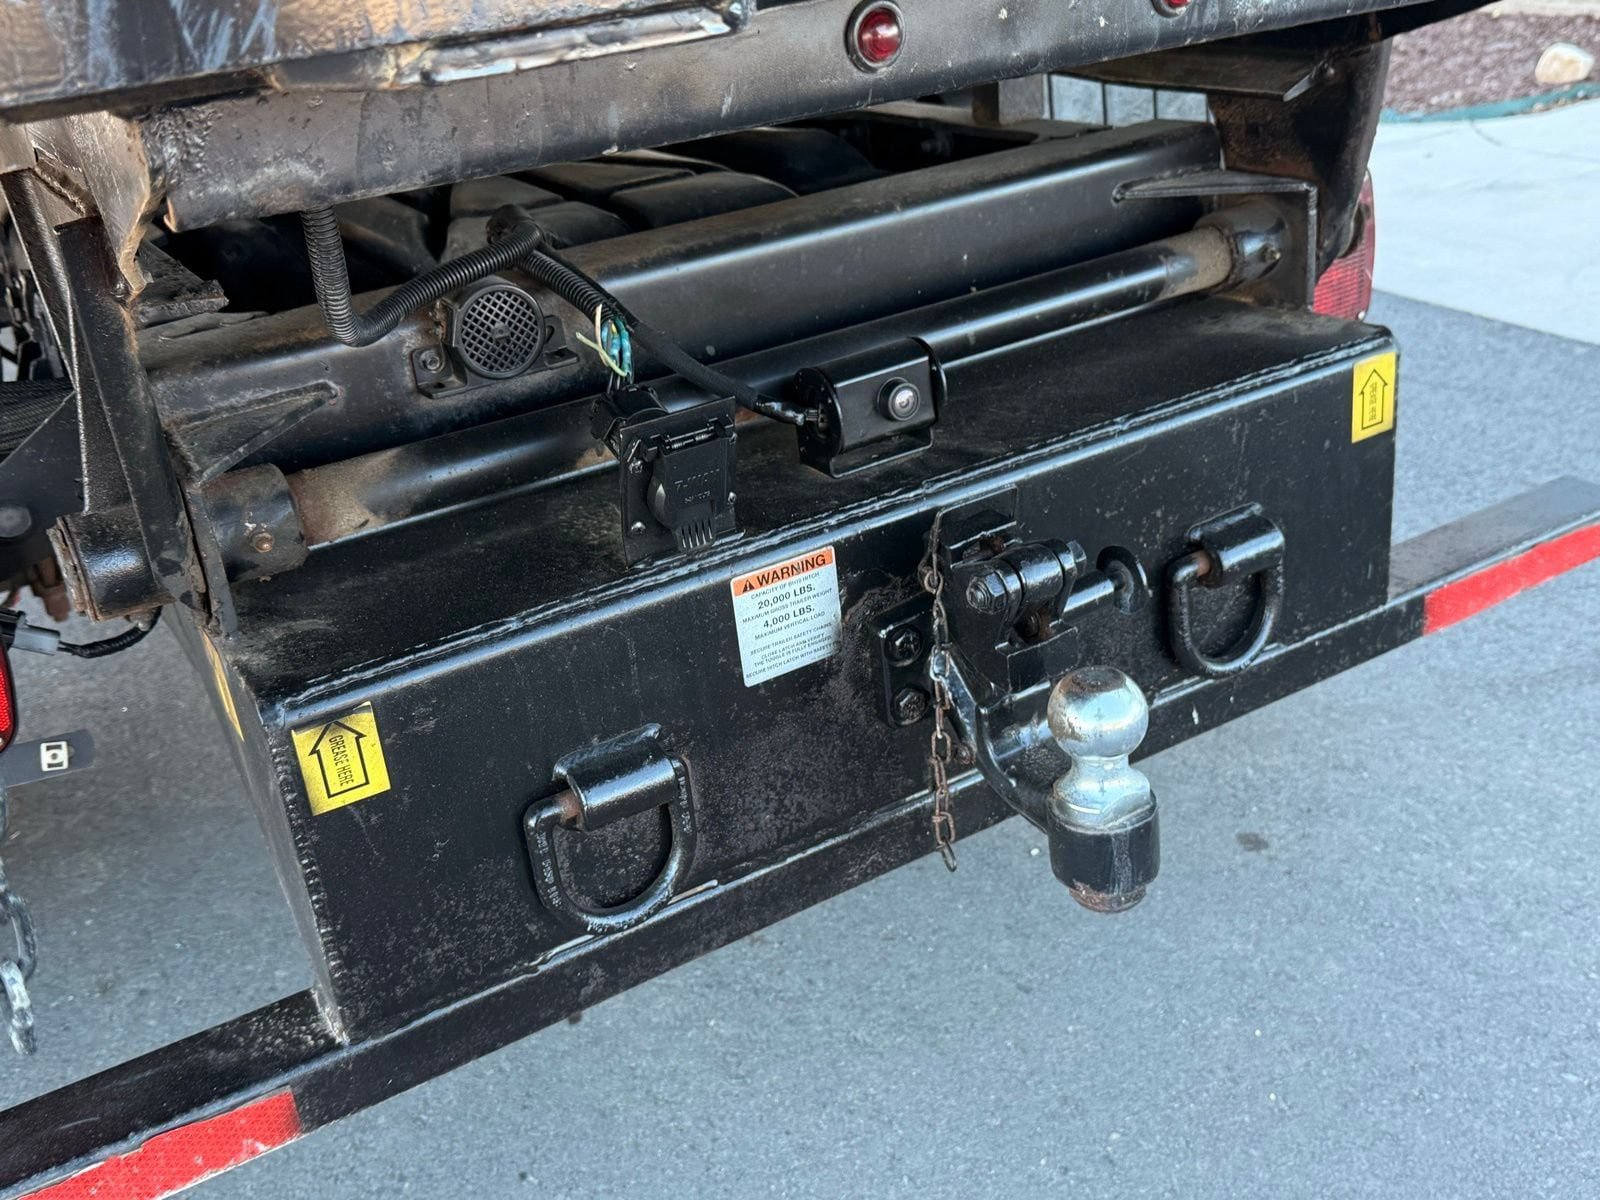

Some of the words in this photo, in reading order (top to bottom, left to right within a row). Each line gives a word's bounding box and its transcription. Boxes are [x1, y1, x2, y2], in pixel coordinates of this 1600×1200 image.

[757, 554, 827, 587] WARNING
[743, 611, 769, 623] MAXIMUM
[771, 604, 789, 614] GROSS
[790, 596, 812, 607] TRAILER
[813, 588, 832, 599] WEIGHT
[751, 587, 778, 600] CAPACITY
[758, 592, 791, 610] 20,000
[794, 584, 816, 597] LBS.
[755, 627, 783, 640] MAXIMUM
[785, 618, 810, 630] VERTICAL
[811, 611, 826, 620] LOAD
[764, 613, 790, 628] 4,000
[794, 605, 815, 618] LBS.
[772, 637, 793, 647] TRAILER
[794, 630, 812, 640] SAFETY
[779, 644, 795, 653] LATCH
[792, 645, 807, 654] FULLY
[767, 662, 783, 670] HITCH
[783, 656, 800, 665] LATCH
[801, 650, 813, 658] WITH
[329, 735, 349, 766] GREASE
[337, 760, 354, 787] HERE
